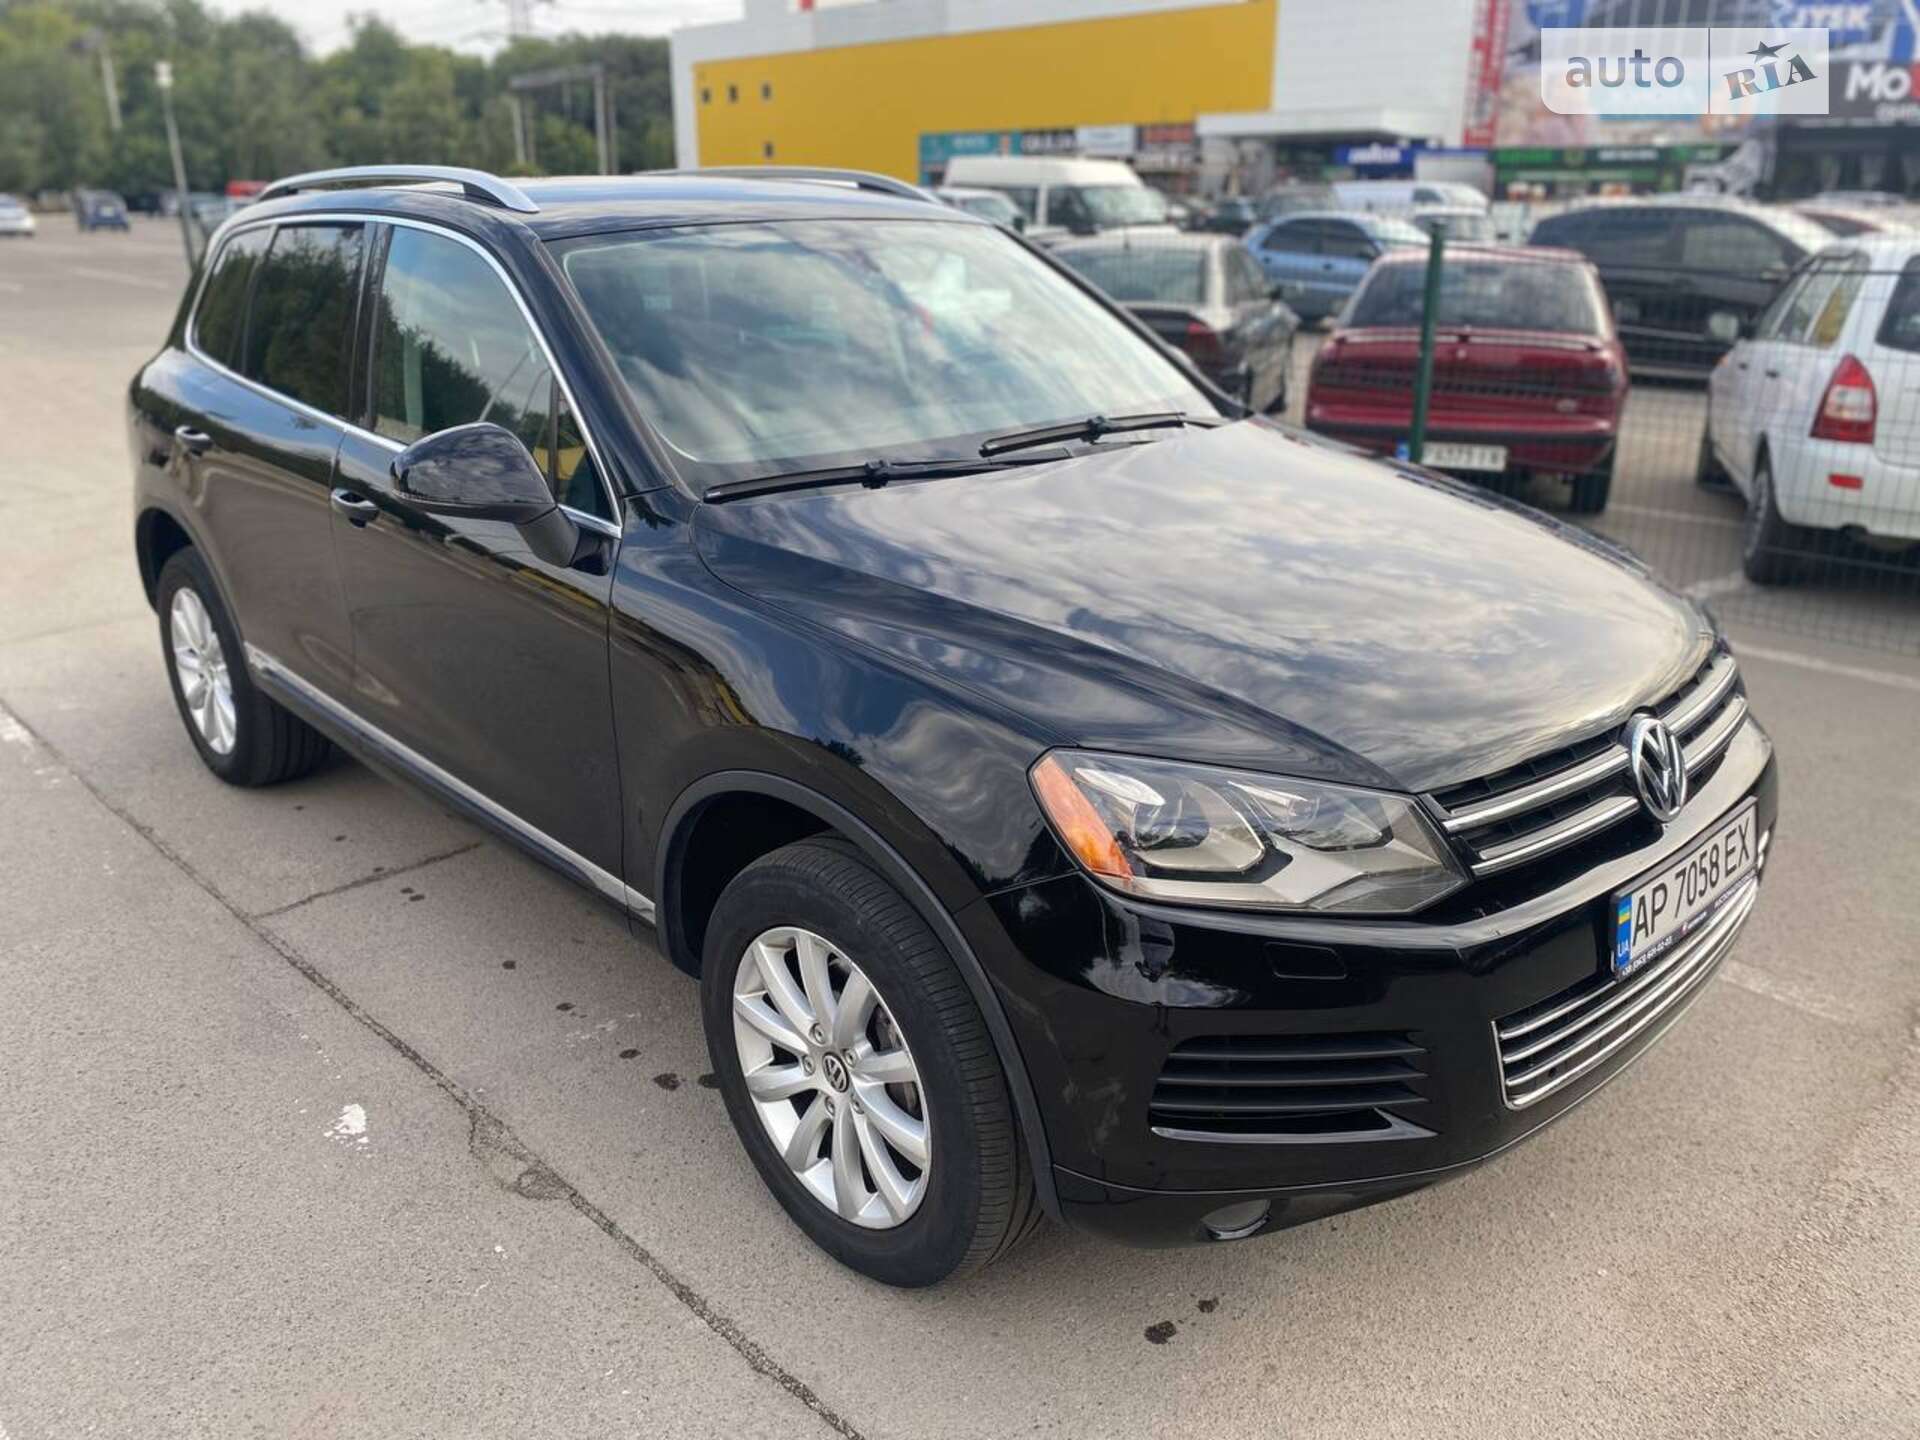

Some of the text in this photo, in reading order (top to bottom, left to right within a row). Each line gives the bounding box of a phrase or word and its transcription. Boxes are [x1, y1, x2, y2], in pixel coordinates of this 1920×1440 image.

[1632, 881, 1668, 947] AP
[1674, 843, 1720, 919] 7058
[1724, 816, 1751, 878] EX
[1617, 939, 1630, 957] UA
